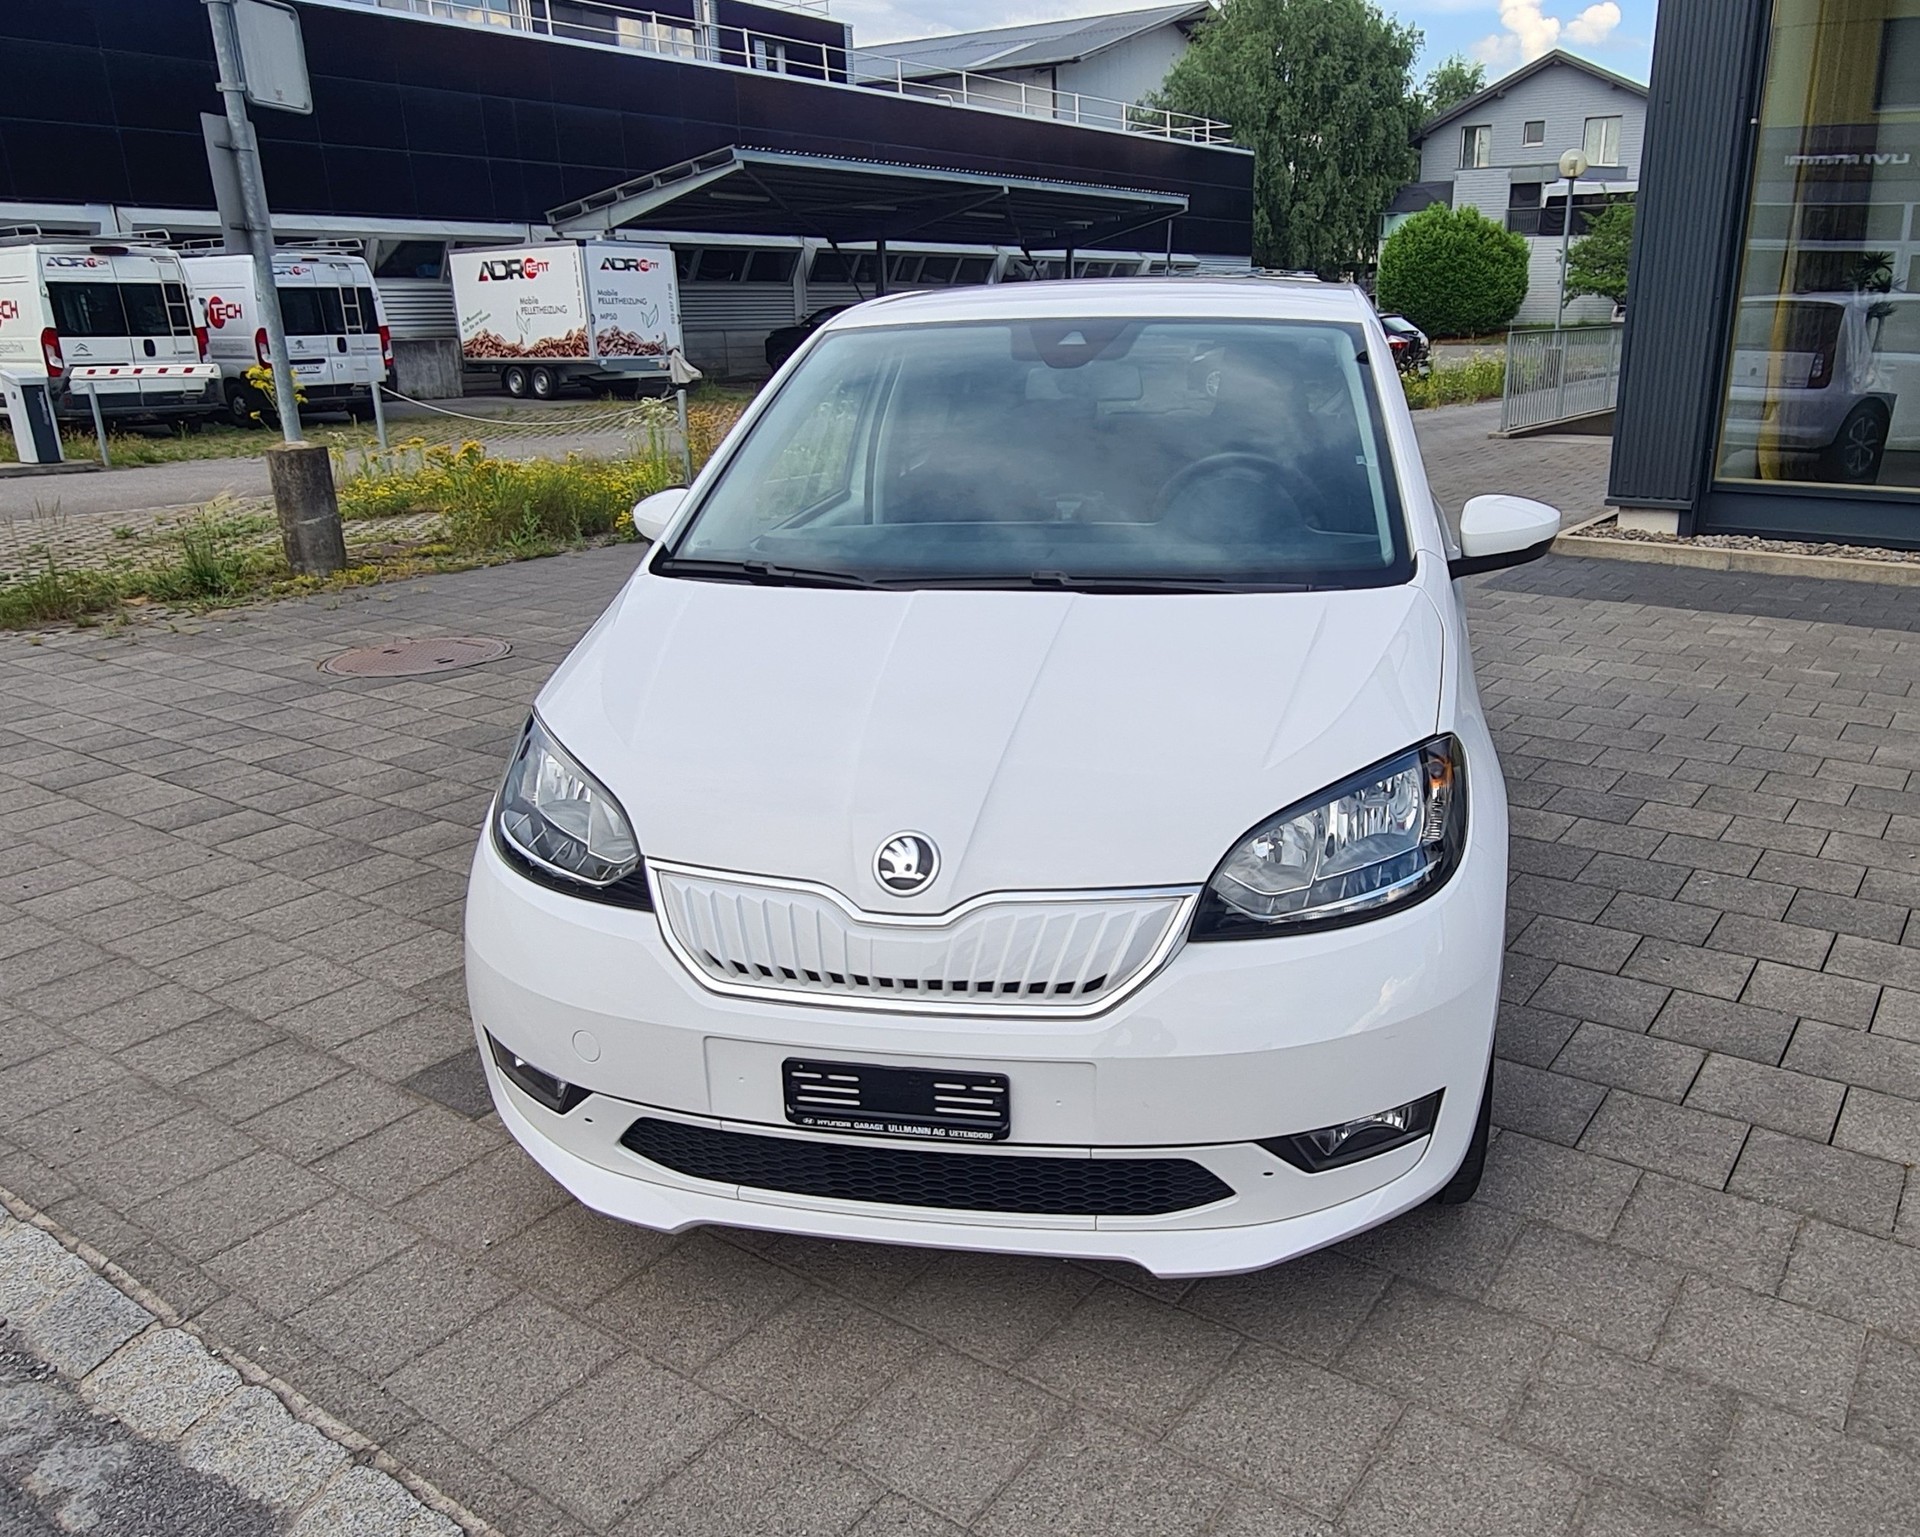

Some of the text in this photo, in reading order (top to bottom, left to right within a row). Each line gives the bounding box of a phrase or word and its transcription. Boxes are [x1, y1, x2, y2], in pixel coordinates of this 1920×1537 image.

[521, 305, 567, 315] PELLETHEIZUNG
[817, 1119, 851, 1128] HYUNDAI
[853, 1122, 884, 1131] GARAGE
[888, 1124, 931, 1135] ULLMANN
[932, 1128, 946, 1136] AG
